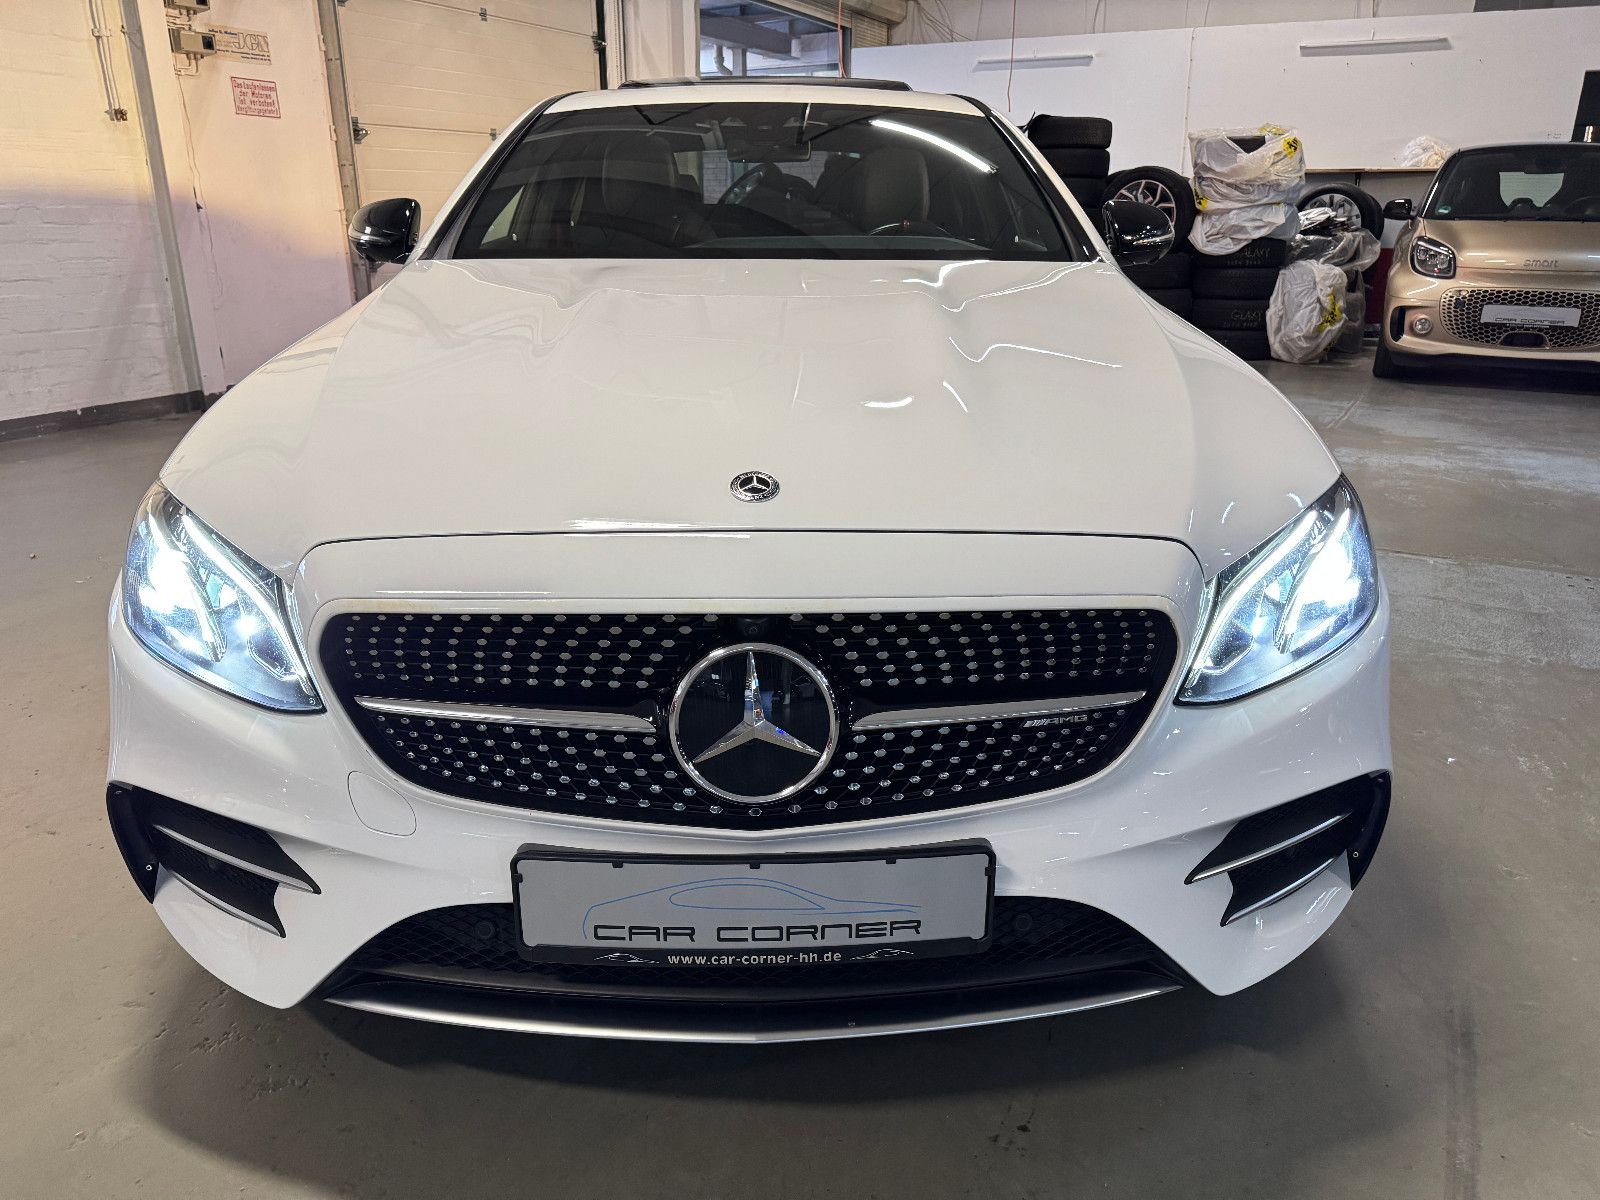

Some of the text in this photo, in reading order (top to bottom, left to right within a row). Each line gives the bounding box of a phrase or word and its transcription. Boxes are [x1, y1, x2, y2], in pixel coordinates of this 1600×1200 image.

[1523, 259, 1559, 268] smart
[1044, 714, 1088, 725] AMG
[593, 919, 922, 943] CAR CORNER
[667, 951, 842, 966] www.car-corner-hh.de
